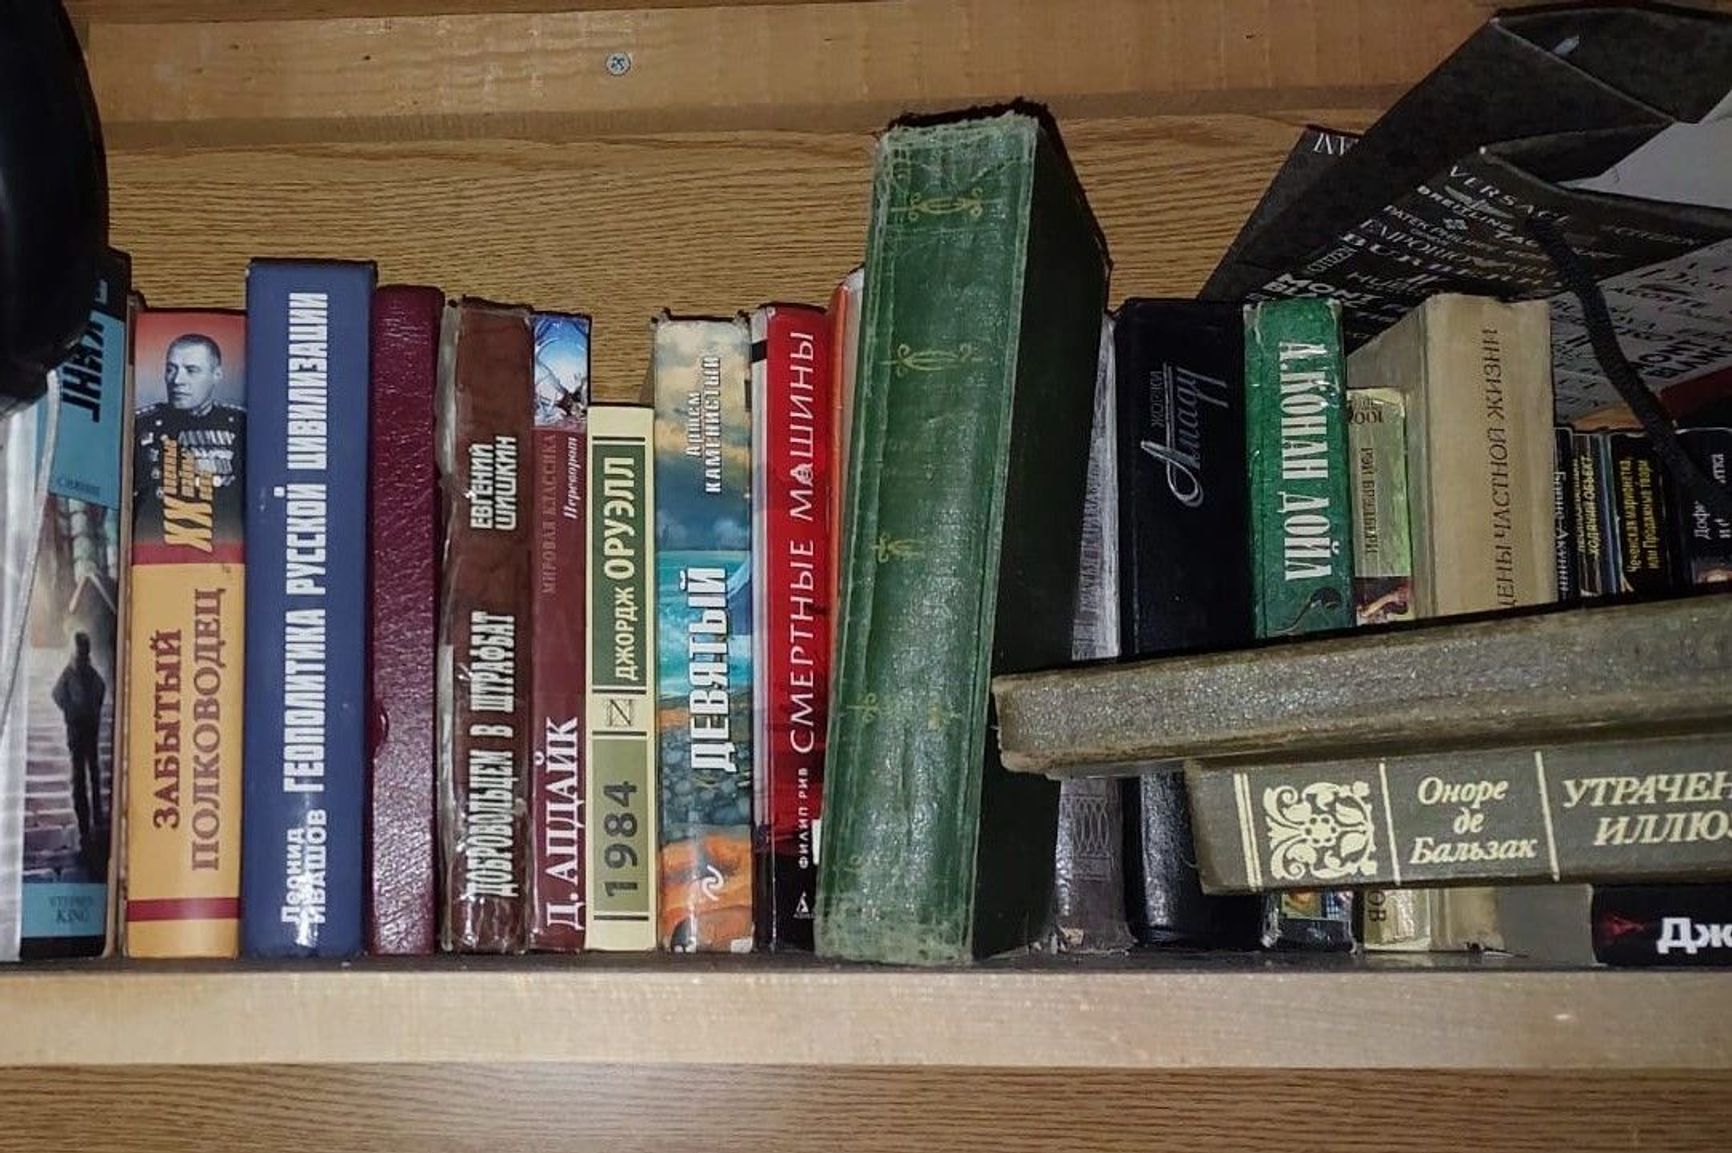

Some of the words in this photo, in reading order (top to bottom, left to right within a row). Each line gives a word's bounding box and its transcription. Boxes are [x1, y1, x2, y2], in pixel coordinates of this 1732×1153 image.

[287, 293, 328, 470] ЦИВИЛИЗАЦИИ
[702, 356, 722, 494] КАМЕНИСТЫЙ
[1481, 328, 1507, 421] ЖИЗНИ
[789, 331, 815, 522] МАШИНЫ
[468, 443, 494, 530] ЕВГЕНИЙ
[495, 436, 518, 531] ШИШКИН
[564, 436, 579, 520] Переворот
[604, 457, 635, 580] ОРУЭЛЛ
[1487, 426, 1514, 540] ЧАСТНОЙ
[274, 484, 327, 595] РУССКОЙ
[1277, 491, 1341, 582] ДОЙЛ
[469, 610, 515, 712] ШТРАФБАТ
[612, 586, 639, 681] ДЖОРДЖ
[680, 567, 737, 773] ДЕВЯТЫЙ
[789, 539, 815, 755] СМЕРТНЫЕ
[150, 629, 181, 830] ЗАБЫТЫЙ
[191, 588, 226, 872] ПОЛКОВОДЕЦ
[283, 608, 326, 793] ГЕОПОЛИТИКА
[469, 724, 514, 738] В
[466, 750, 519, 897] ДОБРОВОЛЬЦЕМ
[797, 767, 810, 801] РИВ
[1417, 776, 1509, 809] Оноре
[1453, 807, 1485, 835] де
[1593, 809, 1732, 848] ИЛЛЮ
[281, 827, 305, 923] Леонид
[305, 808, 327, 924] ИВАШОВ
[603, 781, 638, 897] 1984
[797, 806, 810, 870] ФИЛИП
[1409, 836, 1539, 866] Бальзак
